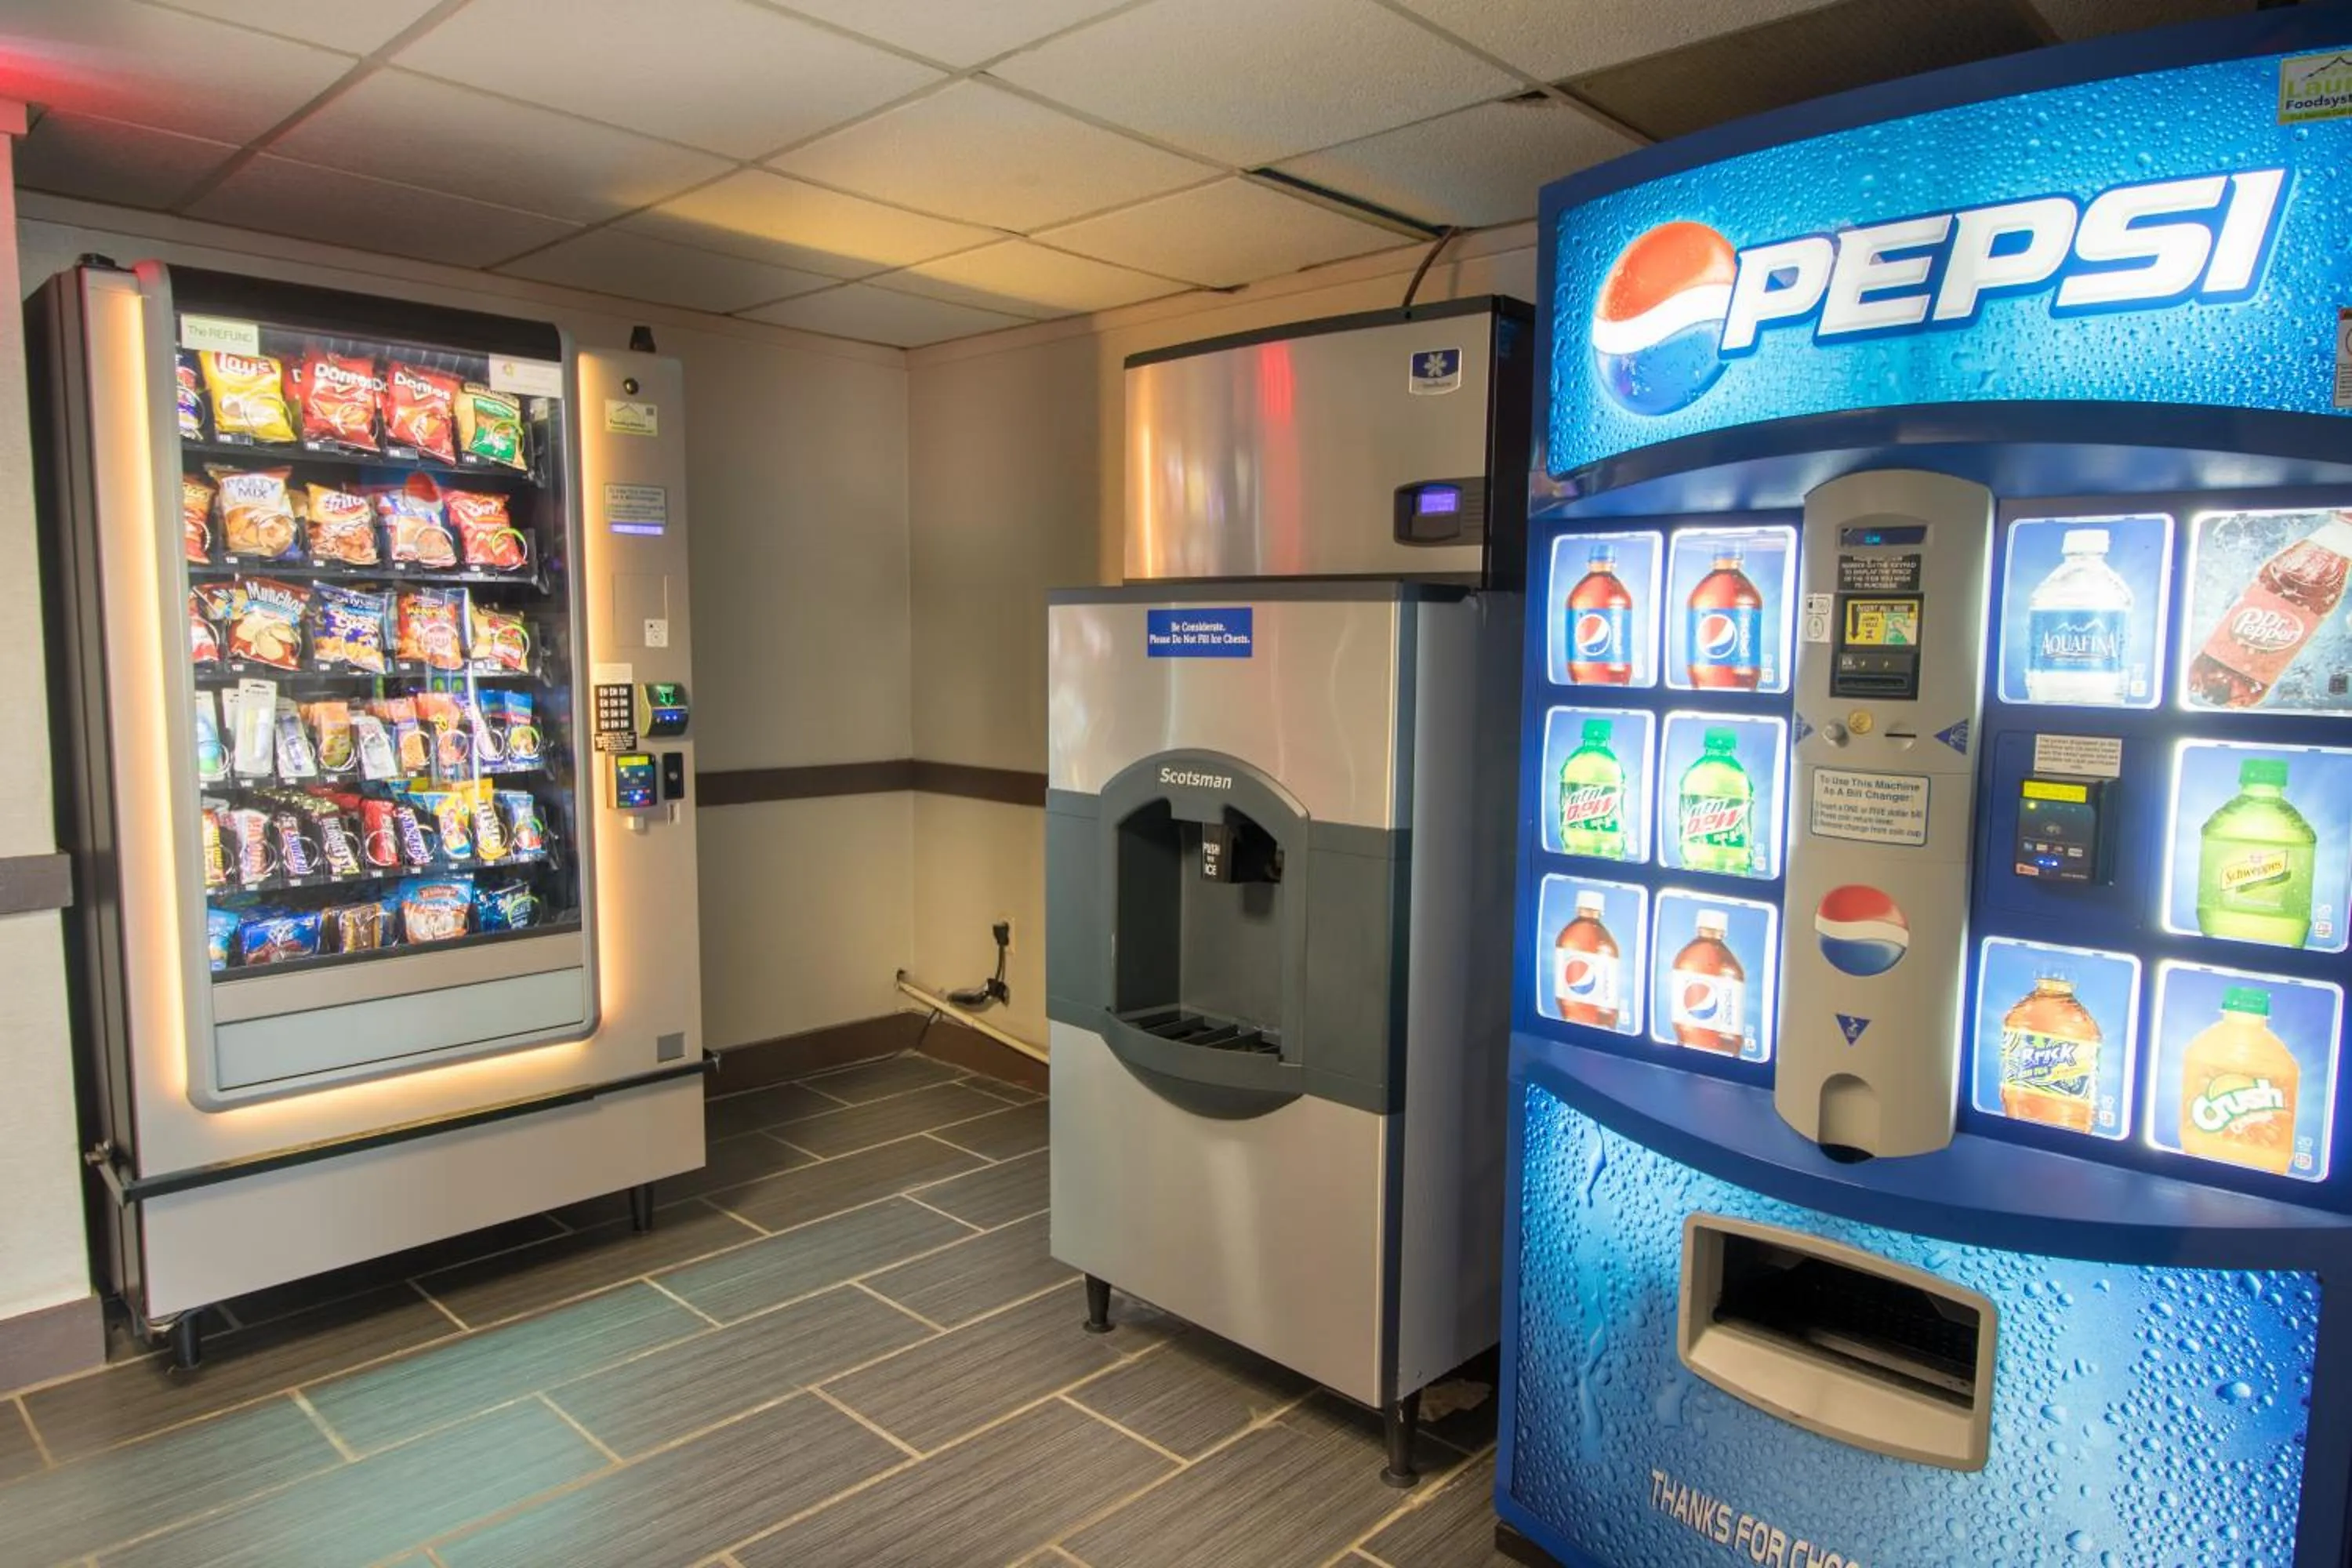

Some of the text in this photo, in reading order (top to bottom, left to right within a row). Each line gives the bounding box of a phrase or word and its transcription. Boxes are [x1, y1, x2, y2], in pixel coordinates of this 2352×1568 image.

[1718, 168, 2285, 350] PEPSI
[209, 328, 253, 342] REFUND
[227, 477, 281, 492] PARTY
[238, 488, 268, 499] MIX
[245, 581, 306, 615] Munchos
[1171, 621, 1225, 631] Be Considerate.
[2234, 608, 2299, 641] Pepper
[1149, 633, 1250, 644] Please Do Not Fill Ice Chests.
[2042, 630, 2118, 659] AQUAFINA
[1160, 767, 1232, 789] Scotsman
[1852, 778, 1872, 787] This
[1875, 780, 1920, 792] Machine
[1203, 841, 1221, 856] PUSH
[1204, 863, 1217, 877] ICE
[2226, 860, 2283, 885] Schweppes
[2021, 1043, 2079, 1067] Brisk
[1650, 1468, 1733, 1544] THANKS
[1733, 1514, 1787, 1568] FOR
